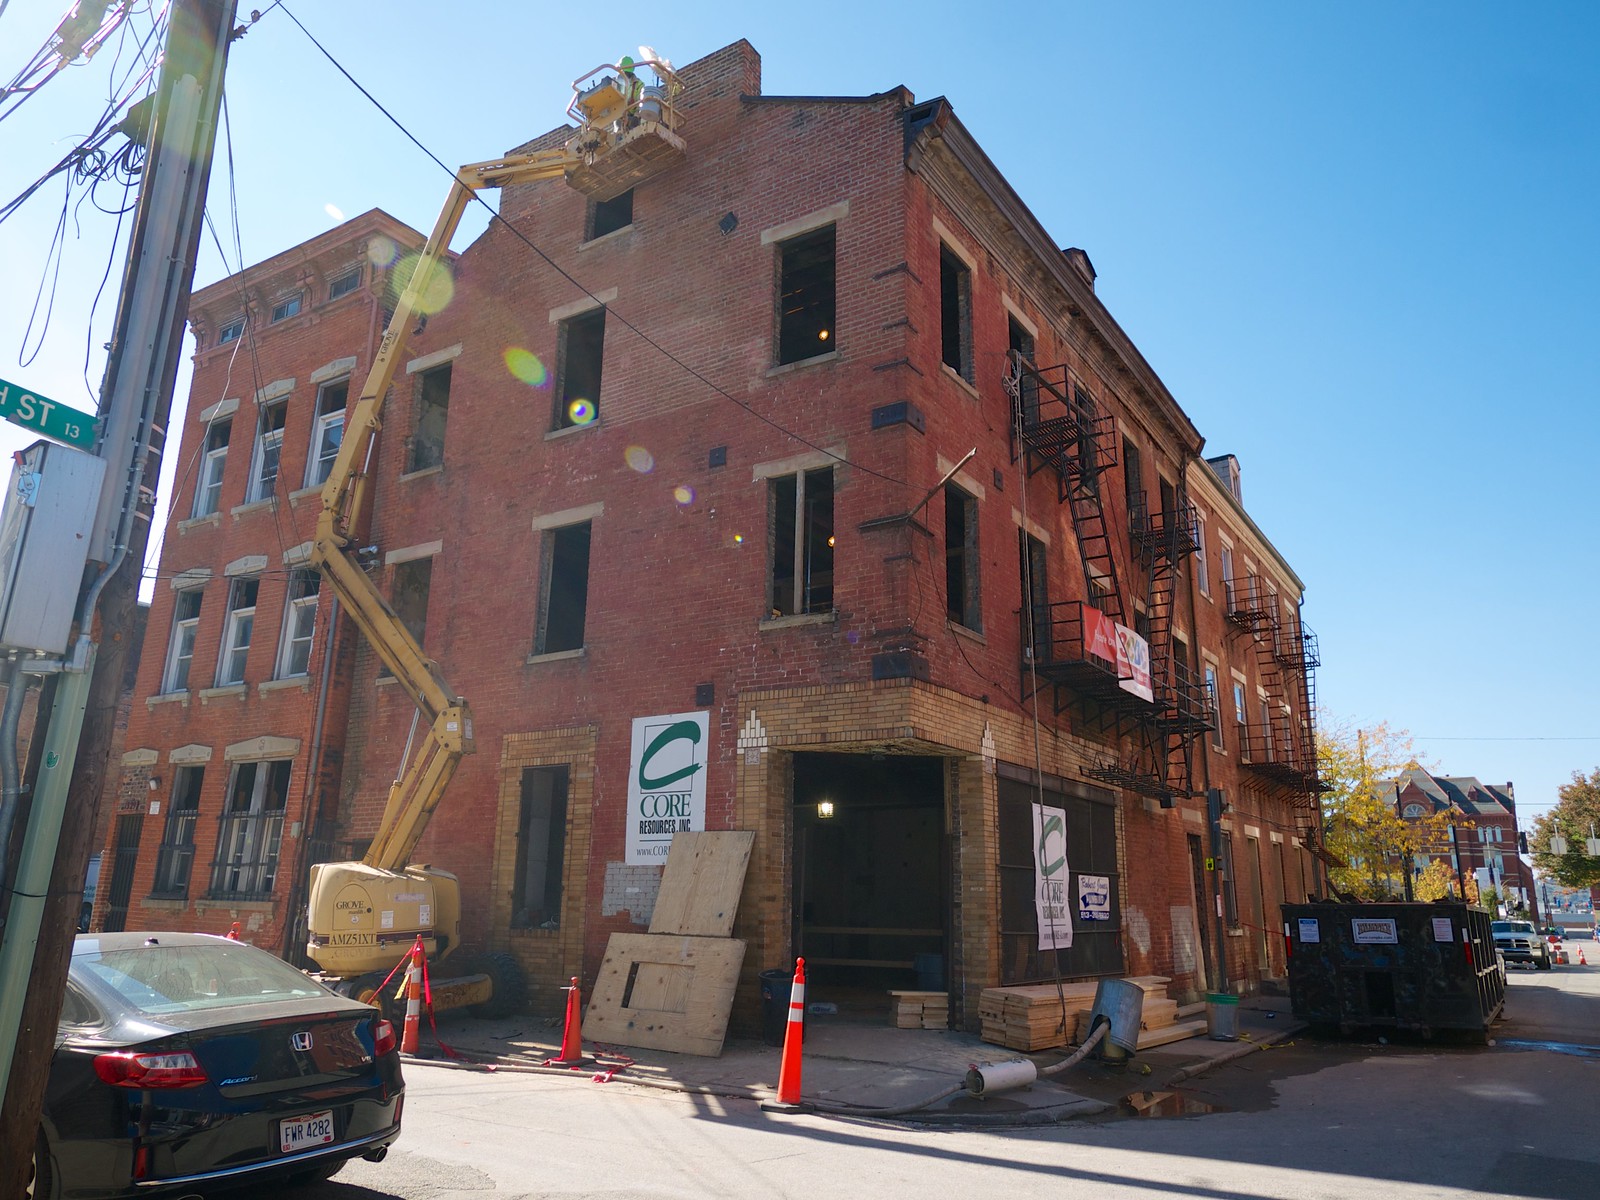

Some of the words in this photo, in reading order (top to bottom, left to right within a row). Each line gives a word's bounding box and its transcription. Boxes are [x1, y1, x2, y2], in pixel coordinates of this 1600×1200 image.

[381, 329, 396, 354] GROVE
[16, 394, 56, 427] ST
[64, 423, 80, 439] 13
[640, 793, 692, 818] CORE
[1041, 882, 1063, 904] CORE
[336, 900, 365, 910] GROVE
[330, 933, 376, 946] AMZ51XT
[219, 1074, 258, 1086] Accord
[285, 1124, 304, 1143] FWR
[306, 1118, 331, 1139] 4282
